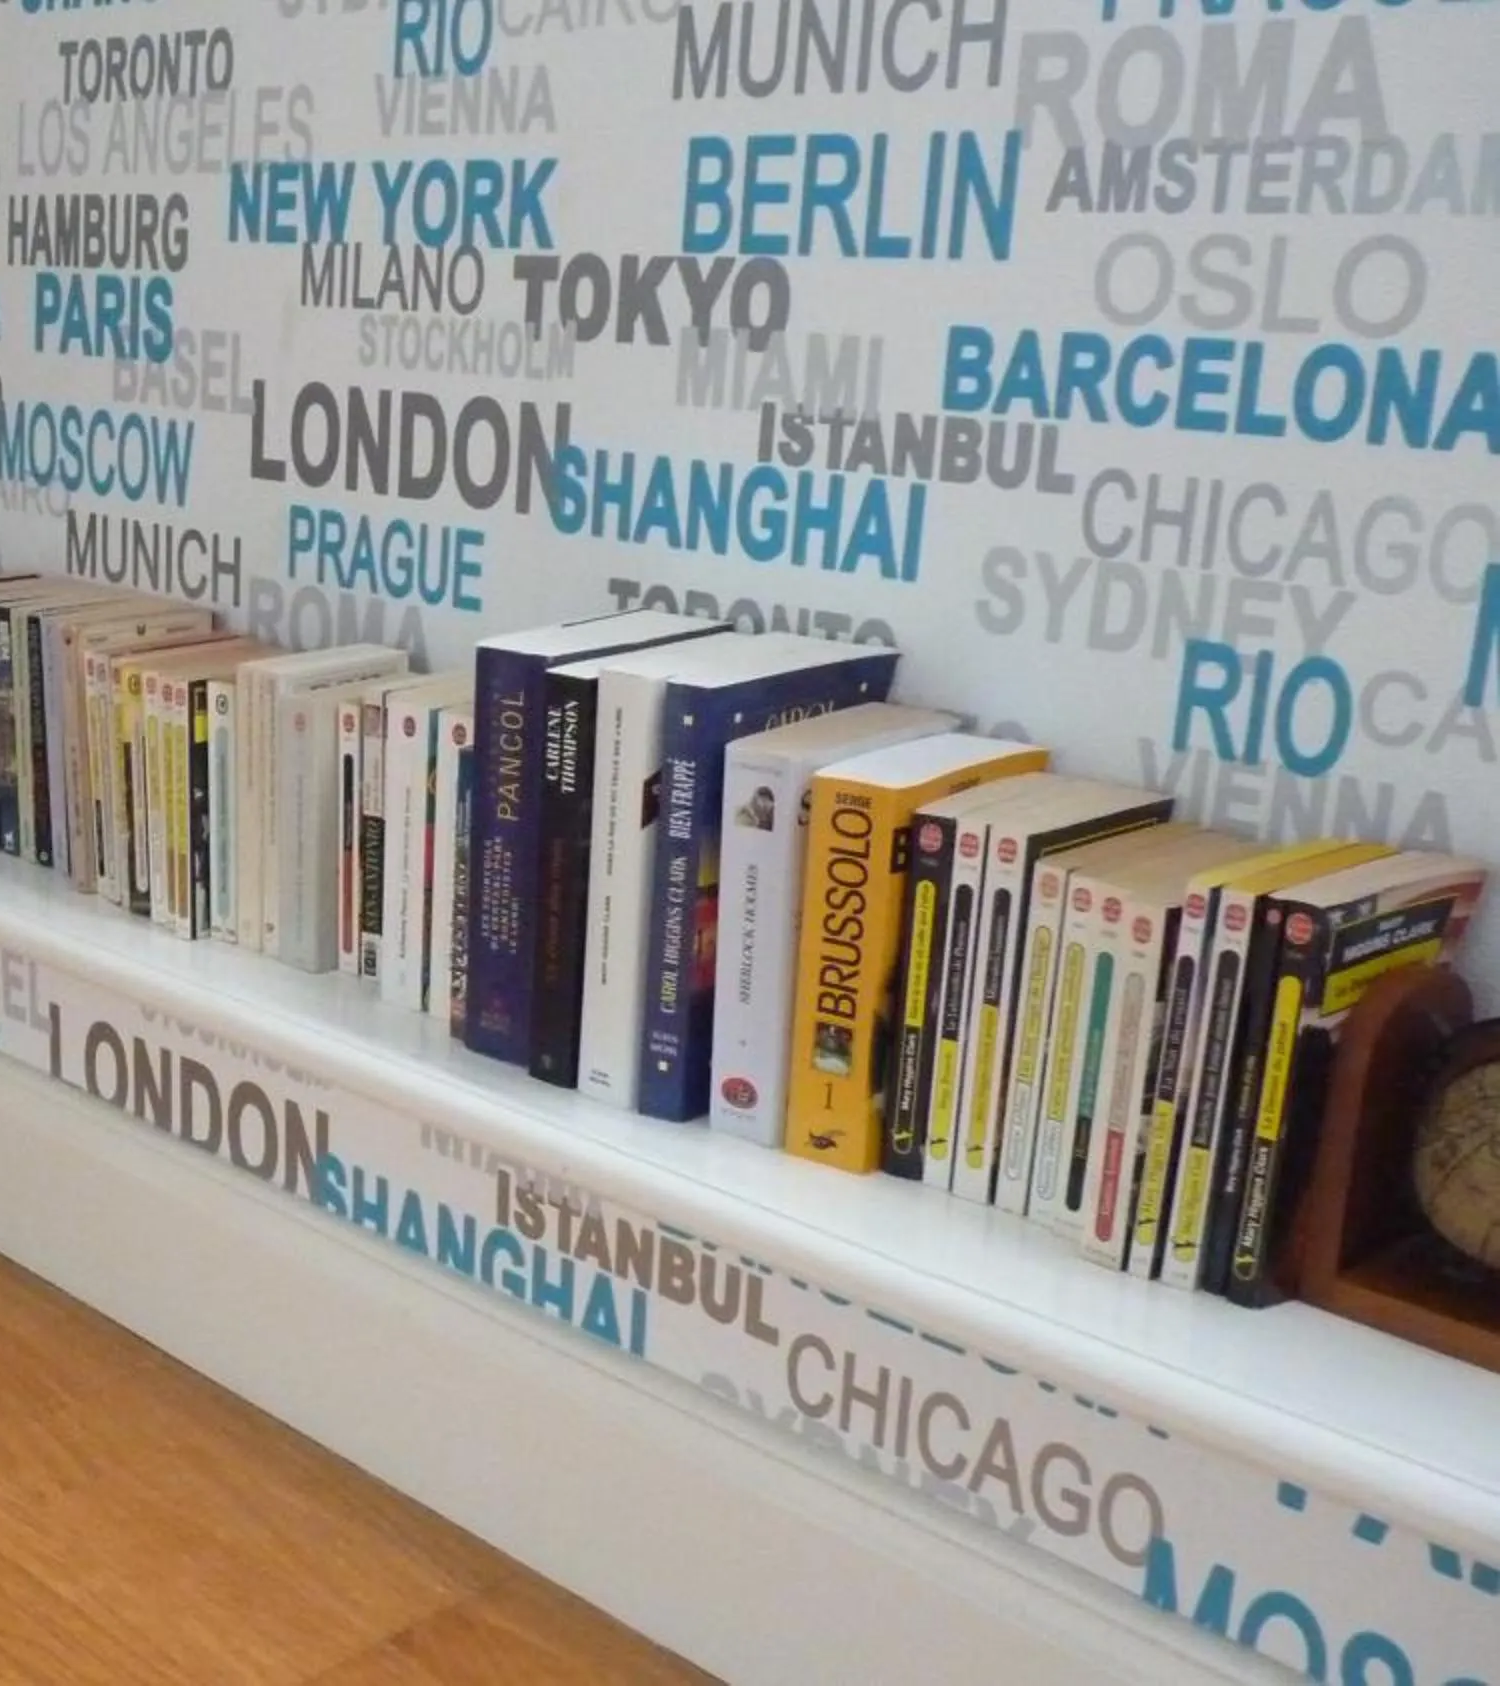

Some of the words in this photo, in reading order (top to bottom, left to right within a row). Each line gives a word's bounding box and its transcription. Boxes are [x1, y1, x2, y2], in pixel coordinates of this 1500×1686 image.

[58, 27, 234, 105] TORONTO
[393, 0, 493, 78] RIO
[672, 0, 1008, 101] MUNICH
[1012, 13, 1391, 152] ROMA
[17, 100, 92, 178] LOS
[101, 83, 316, 176] ANGELES
[375, 65, 558, 138] VIENNA
[7, 193, 189, 272] HAMBURG
[228, 161, 356, 244] NEW
[371, 158, 559, 249] YORK
[682, 129, 1023, 261] BERLIN
[34, 271, 174, 364] PARIS
[300, 241, 485, 315] MILANO
[512, 251, 791, 352] TOKYO
[1093, 231, 1429, 340] OSLO
[112, 328, 257, 416] BASEL
[358, 313, 576, 380] STOCKHOLM
[674, 325, 886, 424] MIAMI
[942, 324, 1500, 457] BARCELONA
[250, 378, 573, 515] LONDON
[757, 401, 1077, 496] ISTANBUL
[65, 509, 242, 608] MUNICH
[287, 504, 485, 612] PRAGUE
[552, 443, 929, 583] SHANGHAI
[1080, 467, 1500, 606] CHICAGO
[250, 577, 432, 675] ROMA
[973, 546, 1358, 663] SYDNEY
[496, 688, 526, 821] PANCOL
[544, 704, 562, 783] CARLENE
[560, 698, 580, 795] THOMPSON
[1173, 638, 1354, 779] RIO
[668, 807, 694, 840] BIEN
[1137, 736, 1456, 855] VIENNA
[667, 854, 689, 904] CLARK
[816, 807, 874, 1021] BRUSSOLO
[659, 968, 680, 1014] CAROL
[49, 1001, 333, 1206] LONDON
[315, 1149, 647, 1358] SHANGHAI
[498, 1169, 779, 1347] ISTANBUL
[786, 1333, 1165, 1567] CHICAGO
